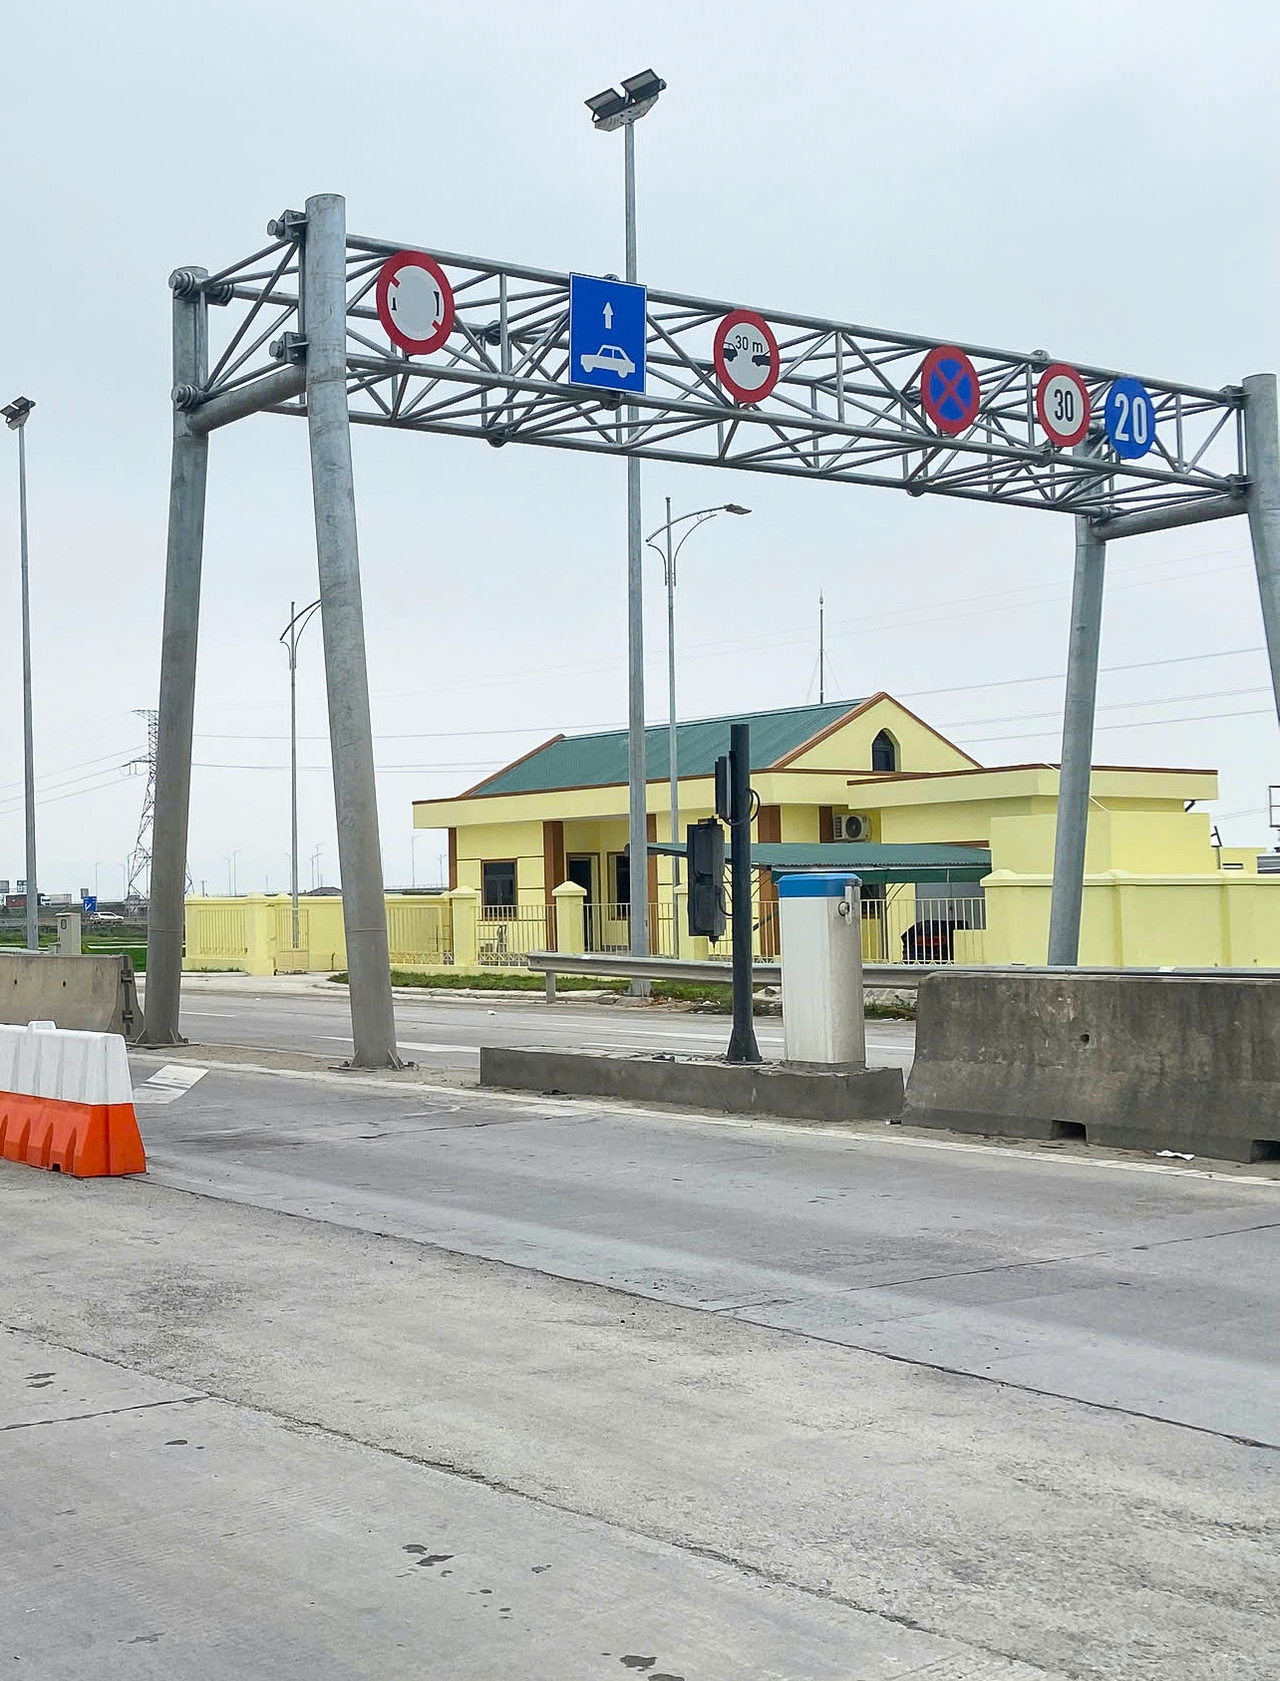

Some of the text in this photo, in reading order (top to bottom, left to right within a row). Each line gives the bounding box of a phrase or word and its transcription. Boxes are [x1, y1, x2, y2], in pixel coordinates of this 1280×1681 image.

[735, 335, 763, 353] 30 m
[1054, 388, 1074, 422] 30
[1114, 392, 1148, 445] 20
